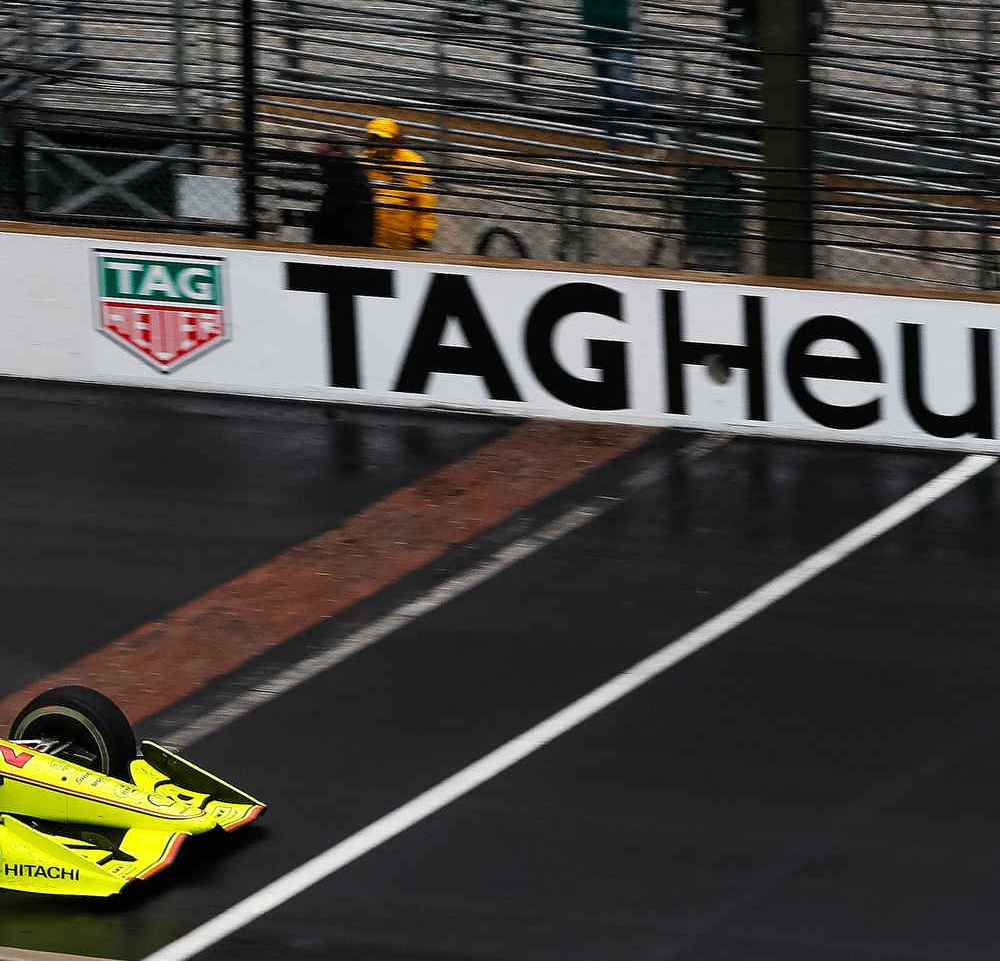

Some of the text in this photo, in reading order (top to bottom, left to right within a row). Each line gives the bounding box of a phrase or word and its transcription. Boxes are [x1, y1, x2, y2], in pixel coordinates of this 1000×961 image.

[104, 261, 213, 301] TAG
[285, 261, 630, 411] TAG
[4, 863, 80, 881] HITACHI
